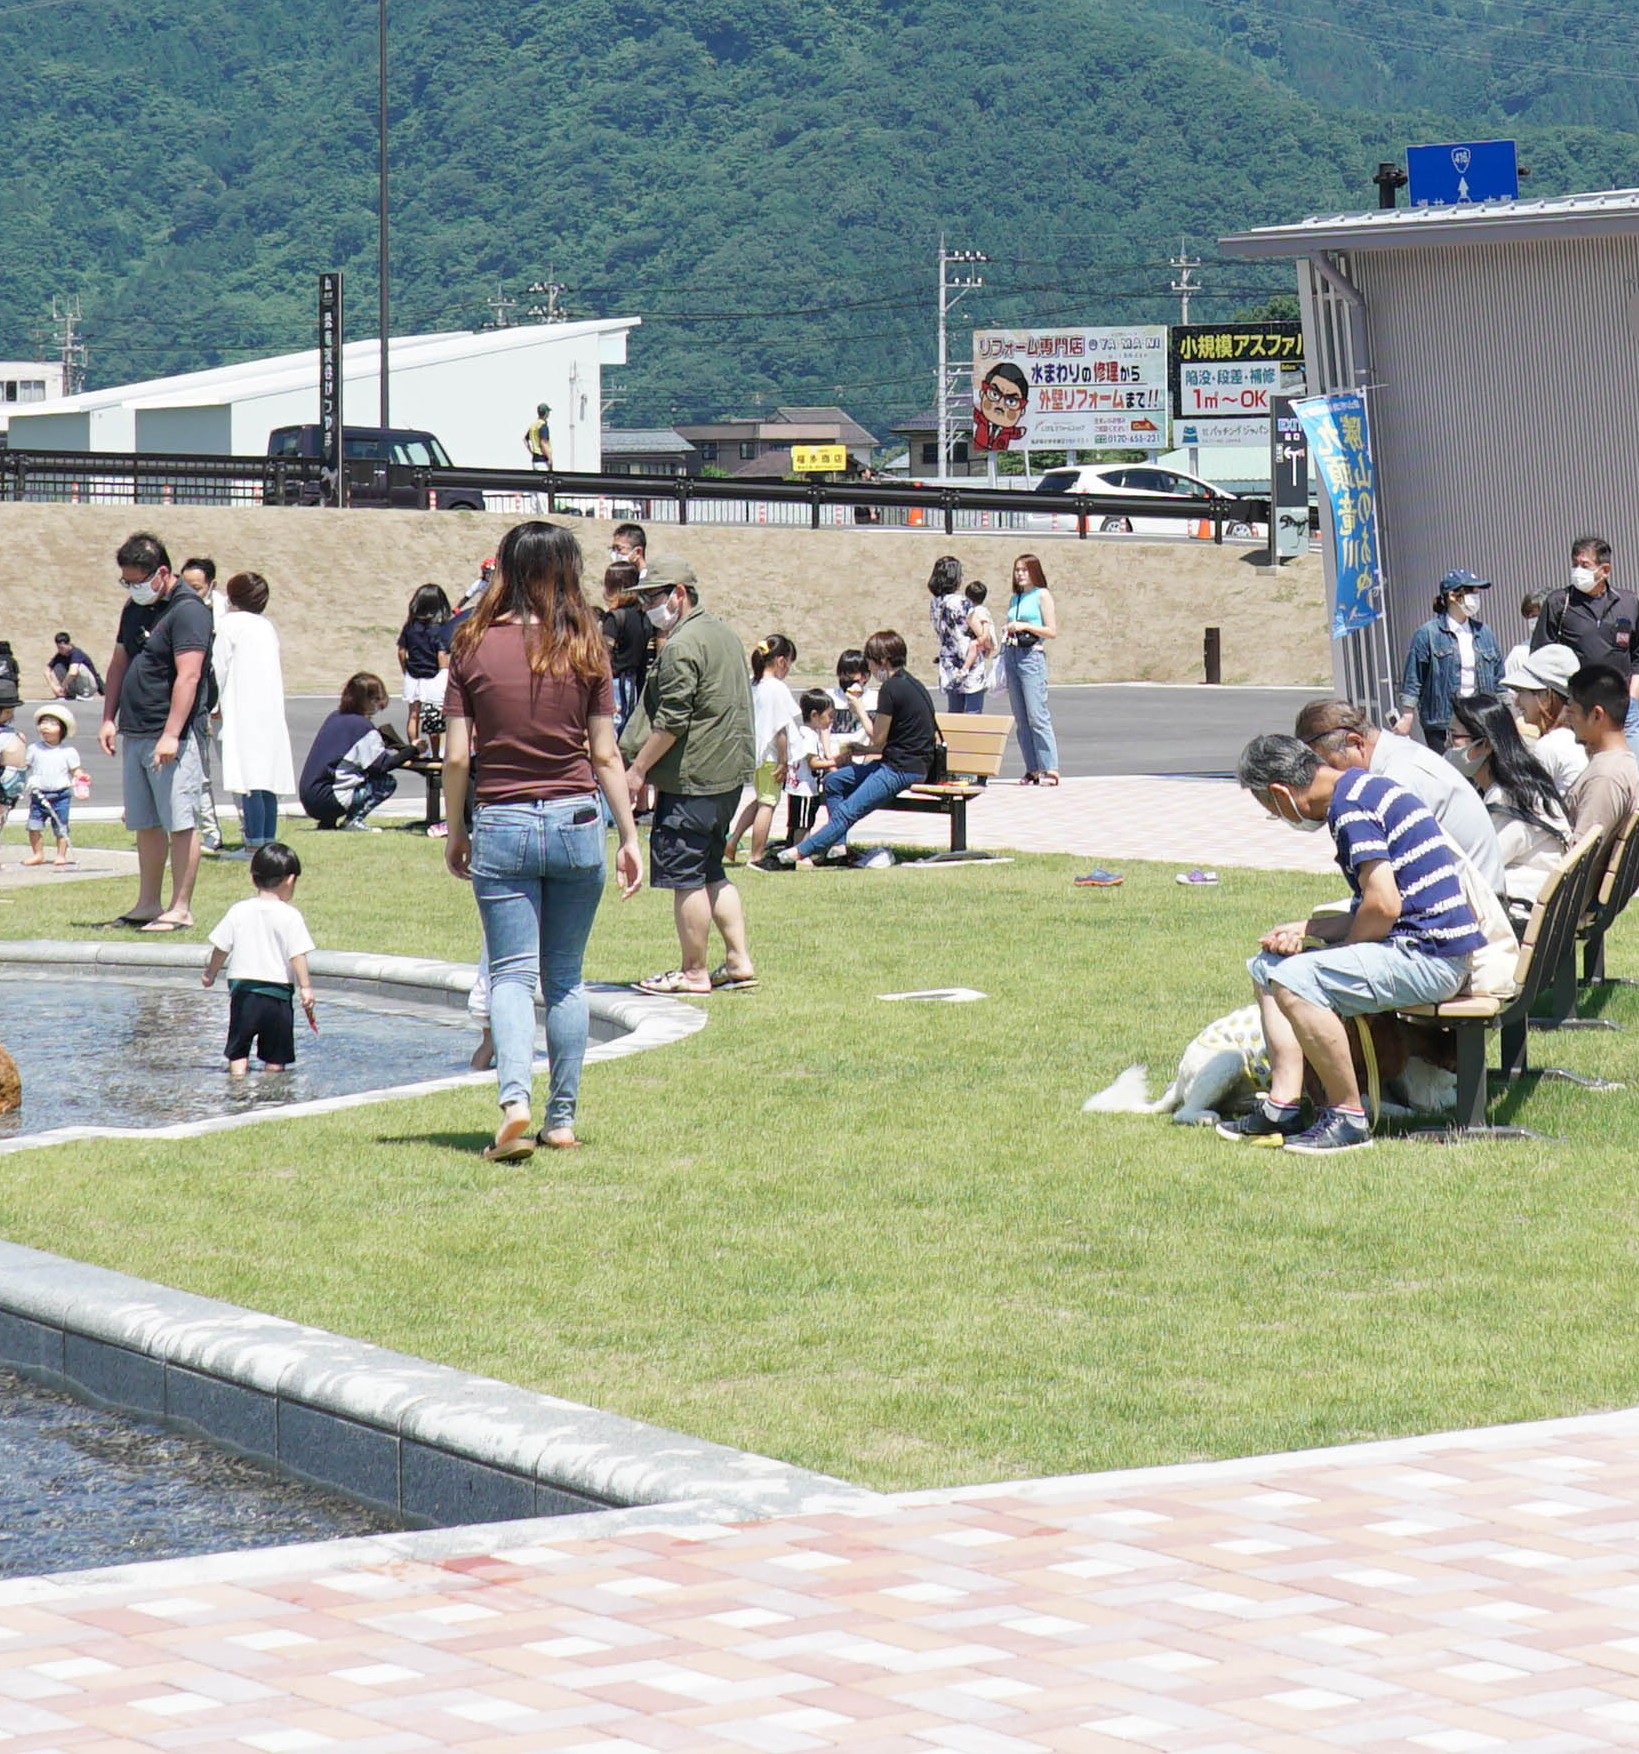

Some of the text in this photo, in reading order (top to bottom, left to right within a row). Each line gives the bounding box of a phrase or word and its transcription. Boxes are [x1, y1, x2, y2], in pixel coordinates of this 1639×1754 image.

[979, 335, 1085, 359] リフォーム専門店
[1031, 361, 1141, 384] 水まわりの修理から
